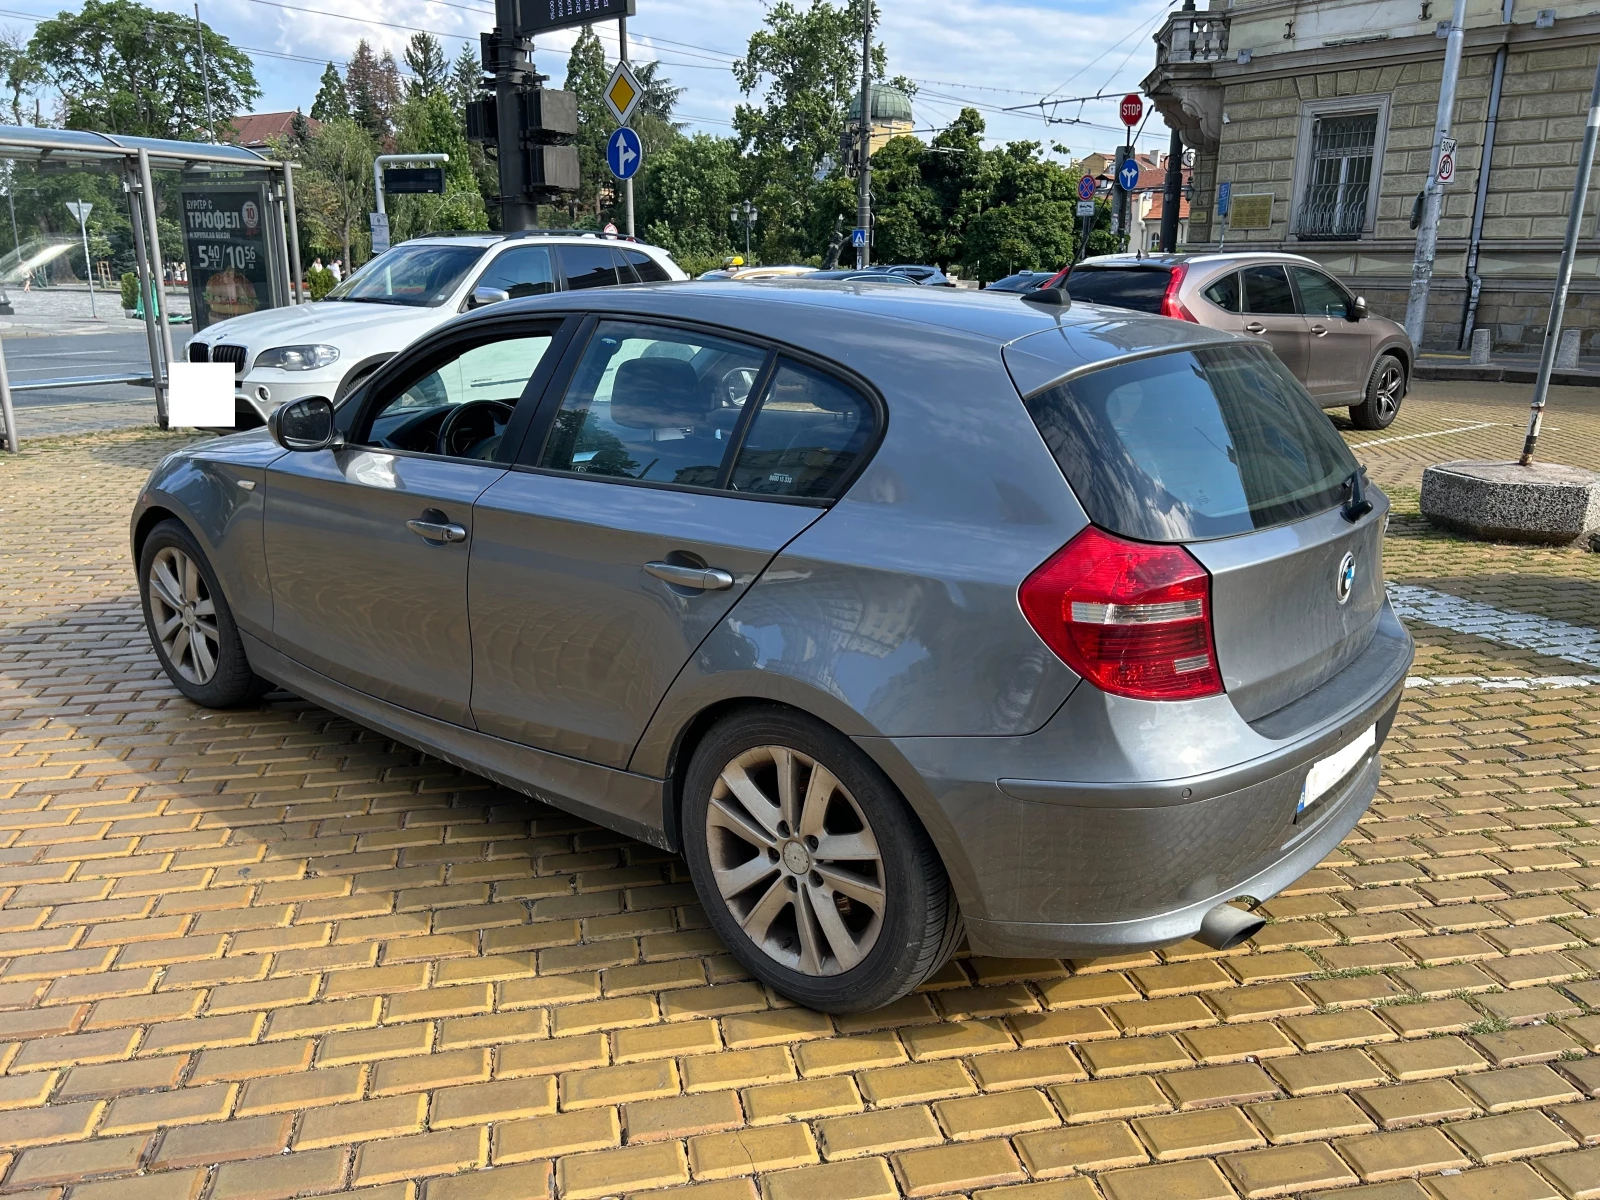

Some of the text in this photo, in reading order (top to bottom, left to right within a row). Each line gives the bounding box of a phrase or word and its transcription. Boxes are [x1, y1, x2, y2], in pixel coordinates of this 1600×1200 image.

[1122, 103, 1141, 116] STOP
[186, 200, 207, 209] БУРГЕР
[246, 207, 255, 219] 10
[187, 210, 240, 230] ТРЮФЕЛ
